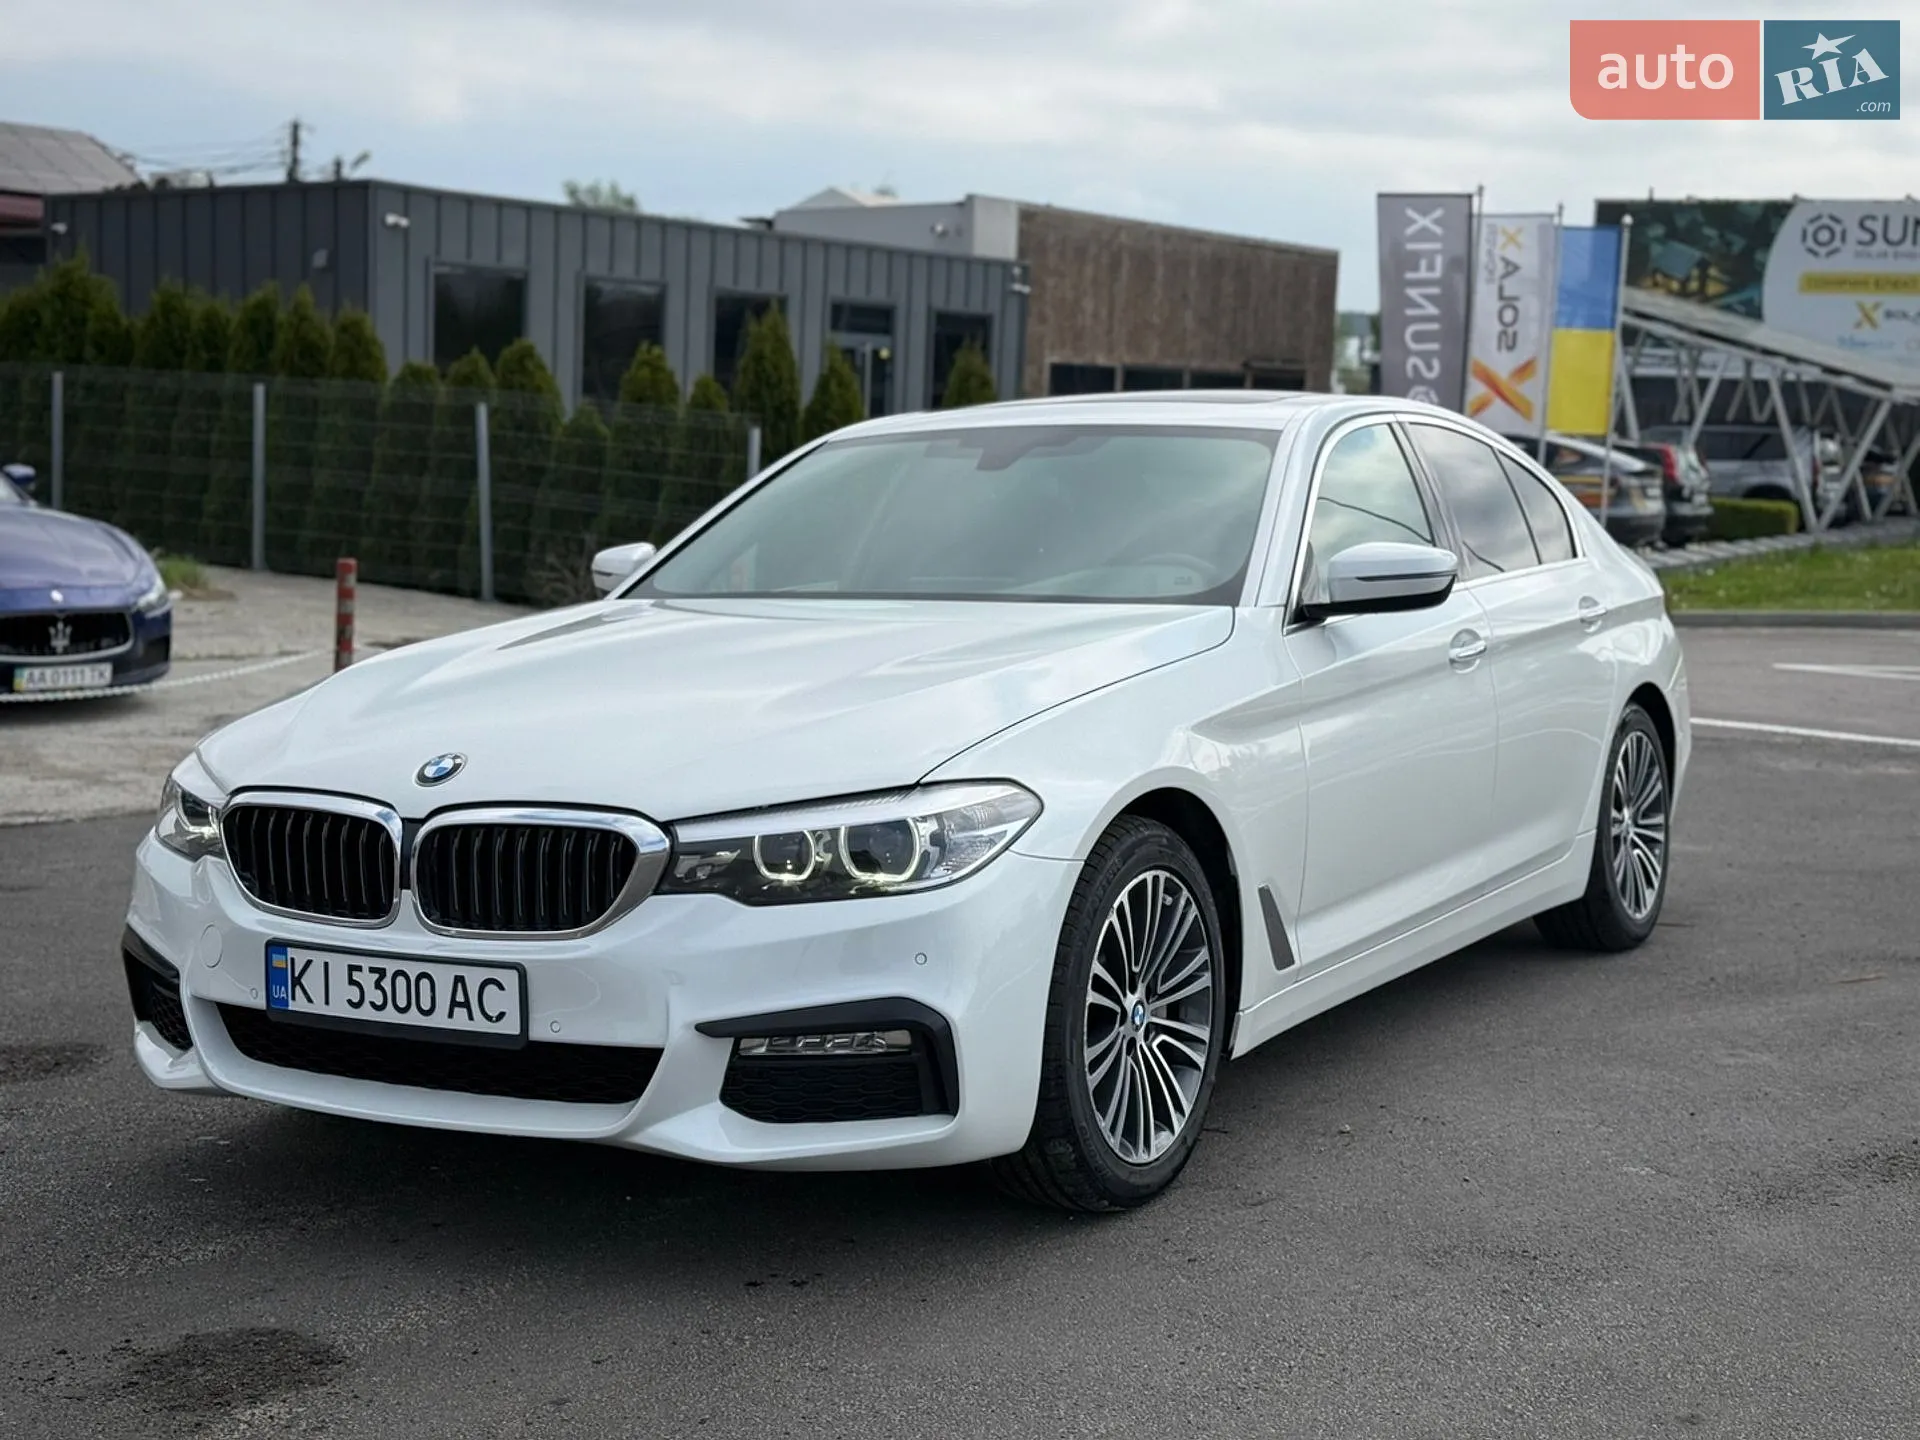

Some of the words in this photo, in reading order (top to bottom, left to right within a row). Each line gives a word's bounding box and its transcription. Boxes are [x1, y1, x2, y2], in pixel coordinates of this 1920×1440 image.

[27, 671, 47, 684] AA
[272, 985, 288, 1000] UA
[289, 956, 331, 1006] KI
[346, 964, 437, 1017] 5300
[447, 974, 507, 1024] AC
